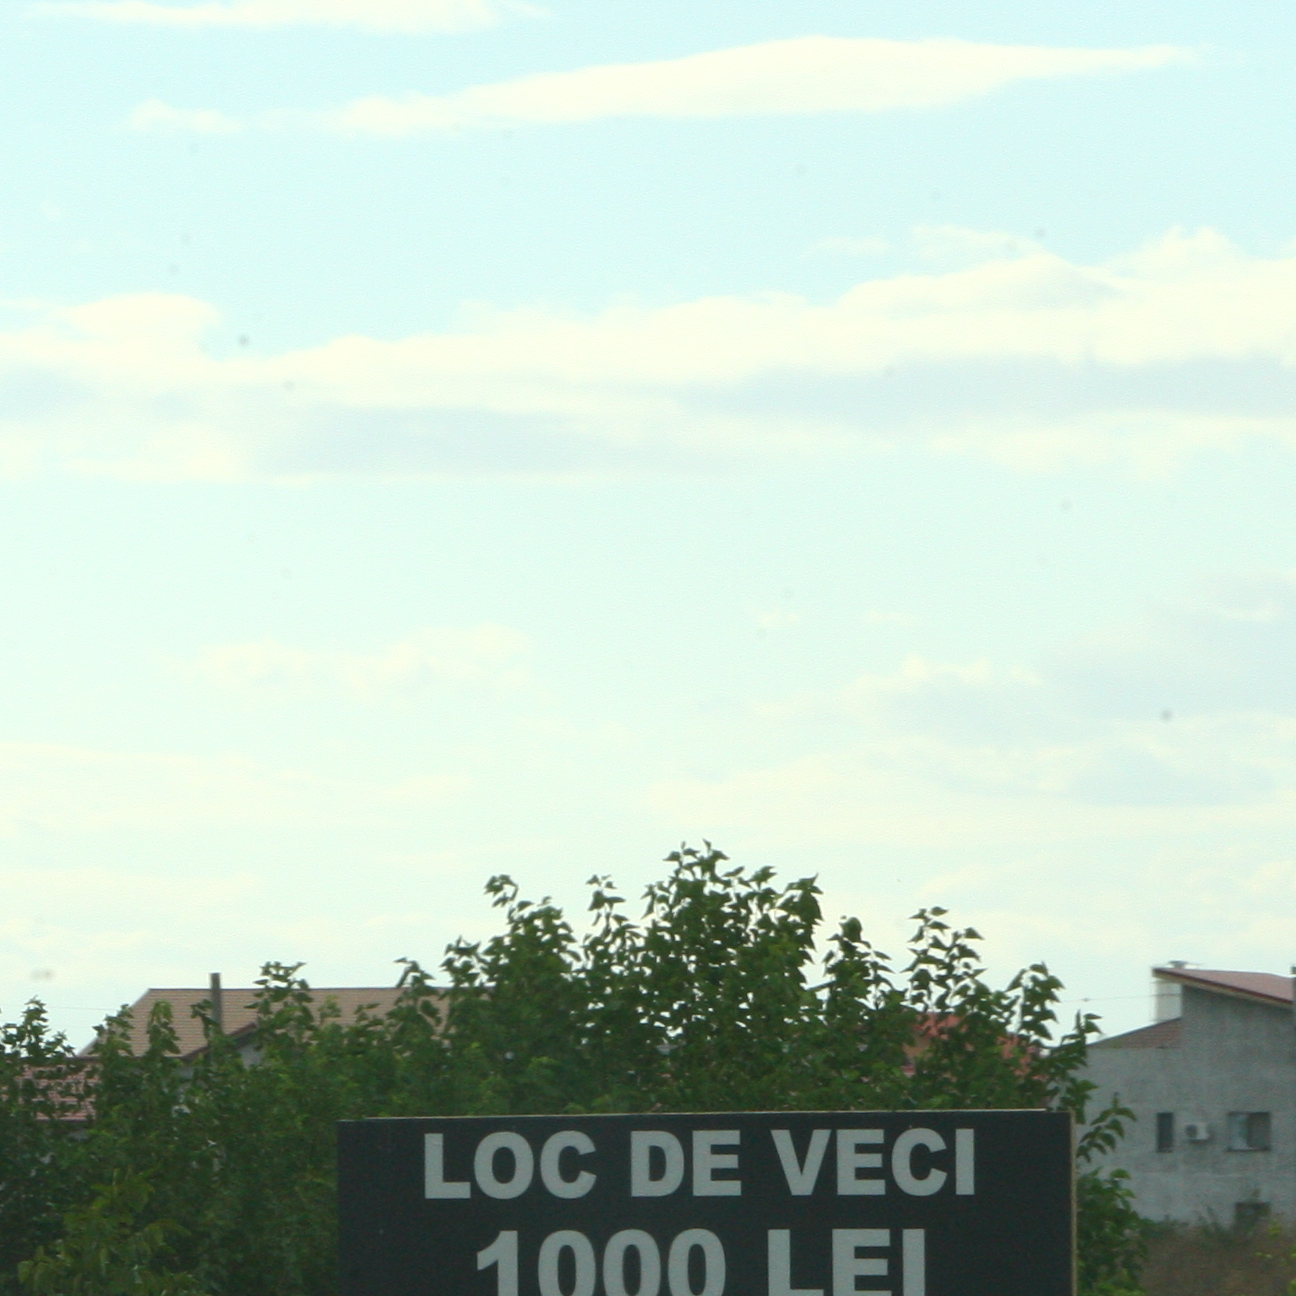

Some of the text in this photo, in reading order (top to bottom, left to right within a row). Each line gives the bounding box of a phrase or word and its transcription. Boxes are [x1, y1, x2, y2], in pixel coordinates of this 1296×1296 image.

[425, 1128, 974, 1199] LOC DE VECI
